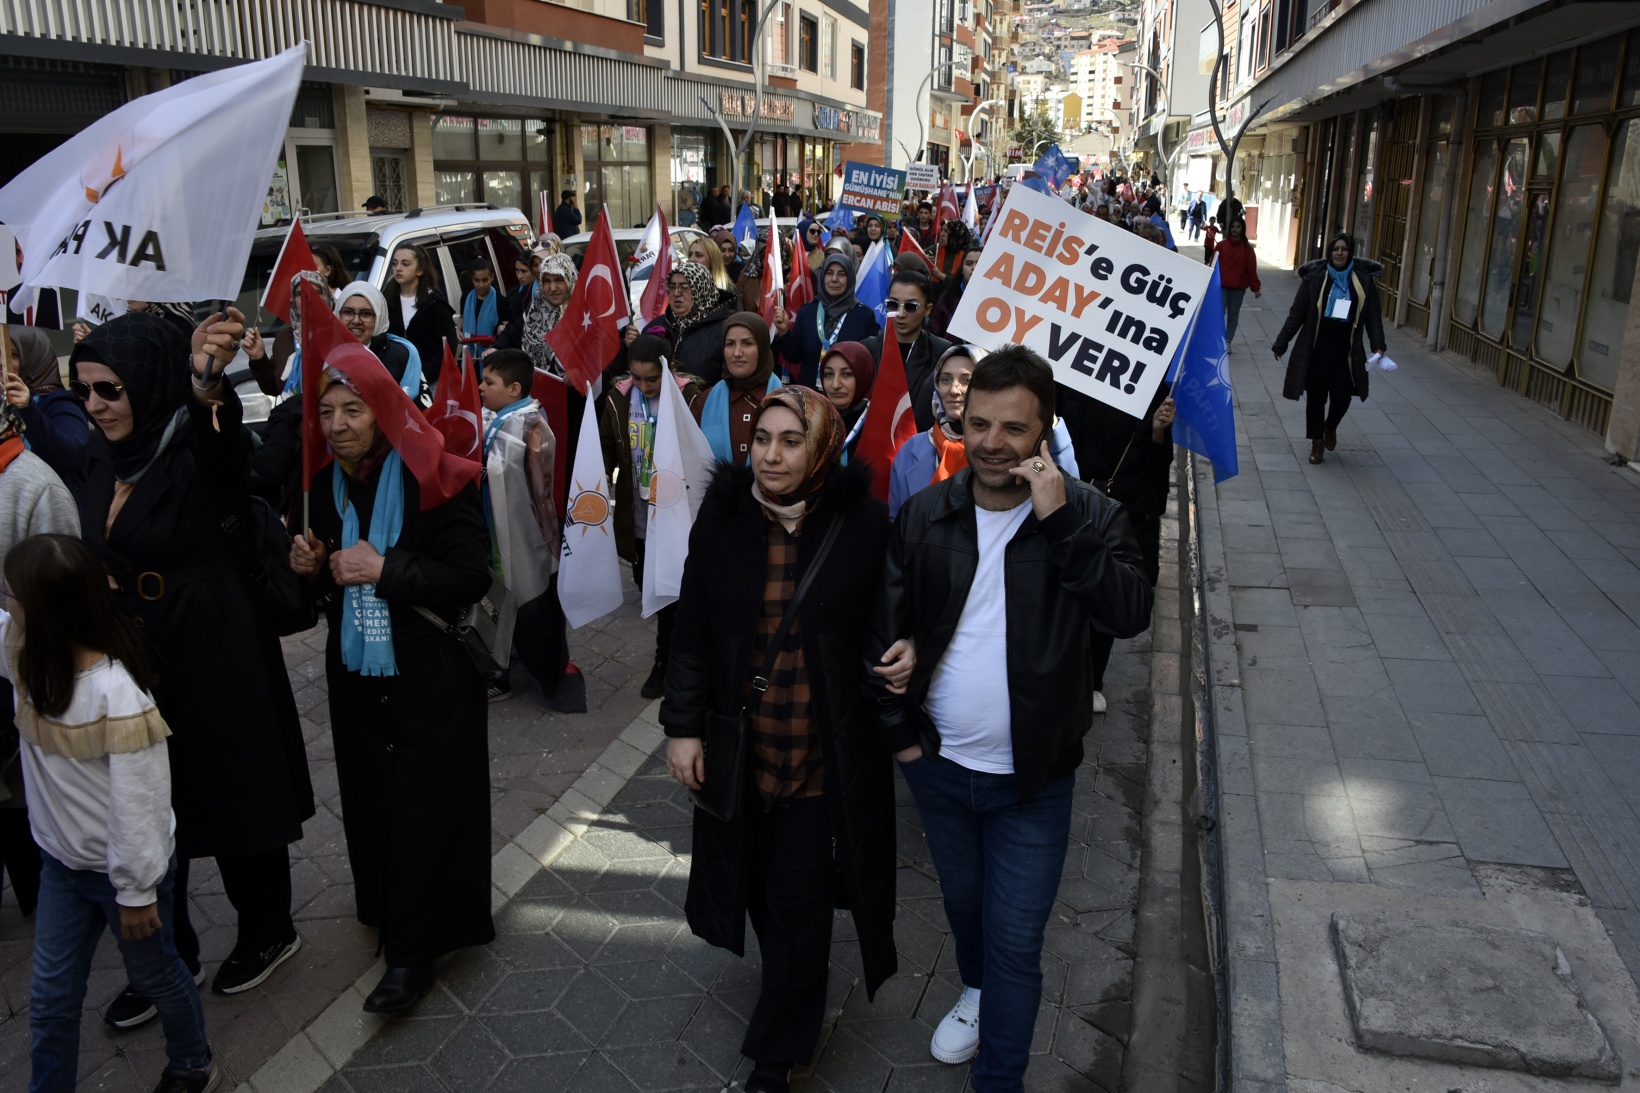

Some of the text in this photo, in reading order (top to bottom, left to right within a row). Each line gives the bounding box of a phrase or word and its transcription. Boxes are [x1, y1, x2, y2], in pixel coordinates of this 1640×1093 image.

[842, 194, 900, 214] ERCAN ABİSİ
[852, 169, 899, 190] EN İYİSİ
[998, 208, 1192, 320] REİS'e Güç
[90, 302, 115, 322] AK
[982, 251, 1170, 356] ADAY'ına
[975, 297, 1147, 395] OY VER!
